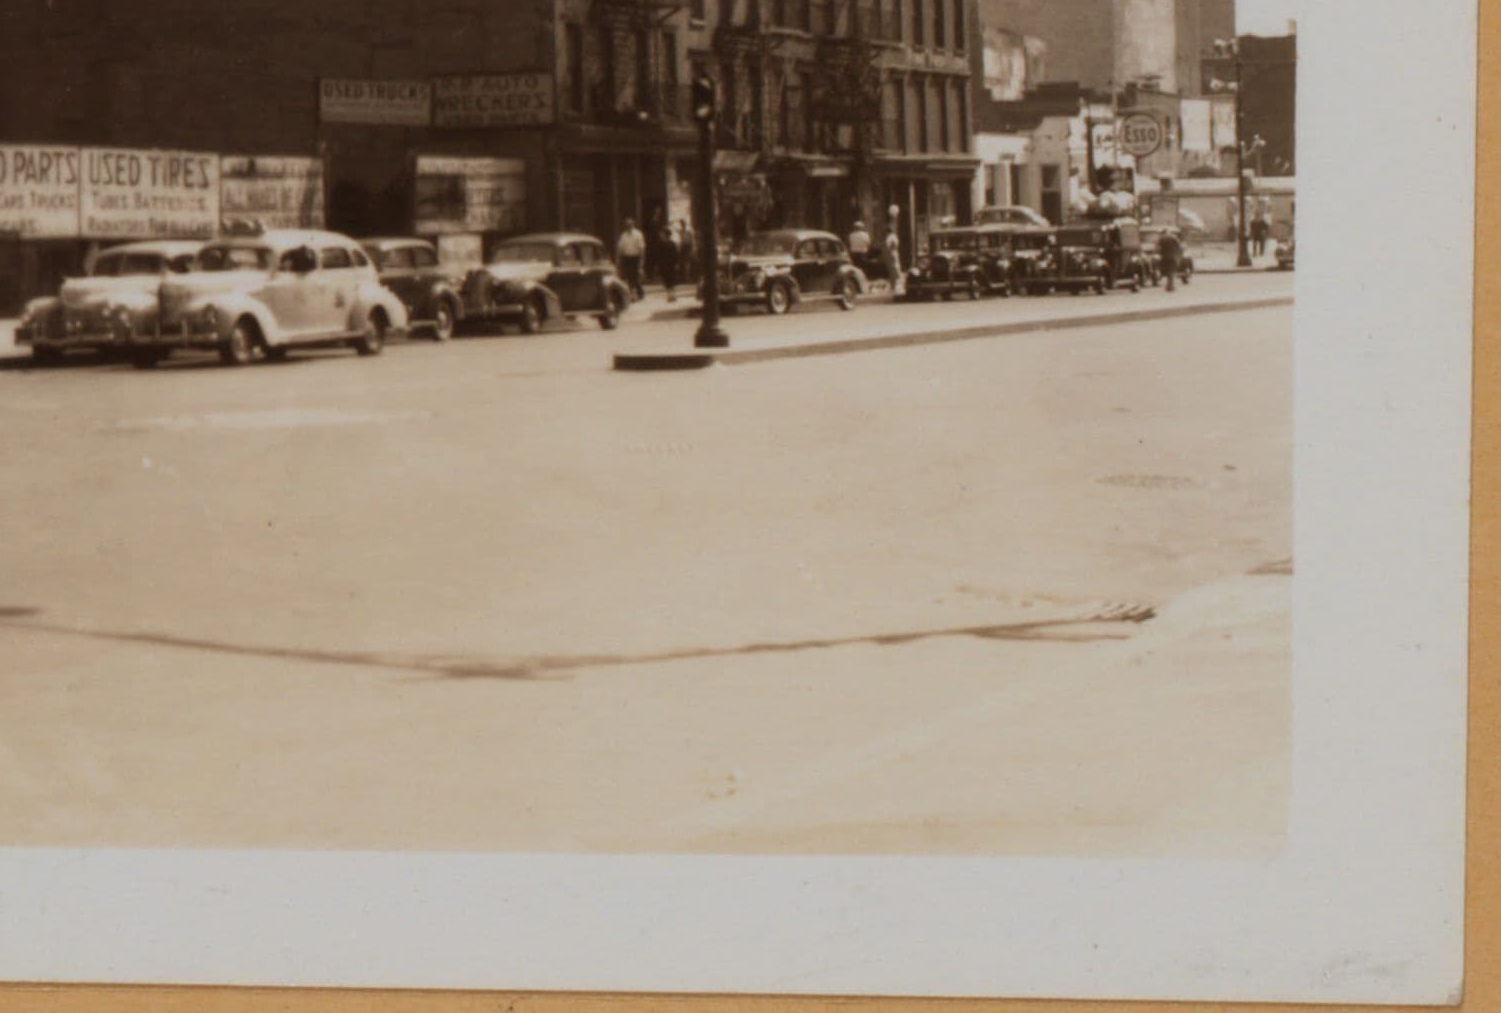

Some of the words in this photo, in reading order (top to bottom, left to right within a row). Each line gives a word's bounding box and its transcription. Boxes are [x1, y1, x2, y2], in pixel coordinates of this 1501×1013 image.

[323, 82, 364, 100] USED
[367, 82, 429, 101] TRUCKS
[13, 150, 78, 185] PARTS
[88, 151, 141, 187] USED
[146, 153, 211, 191] TIRES
